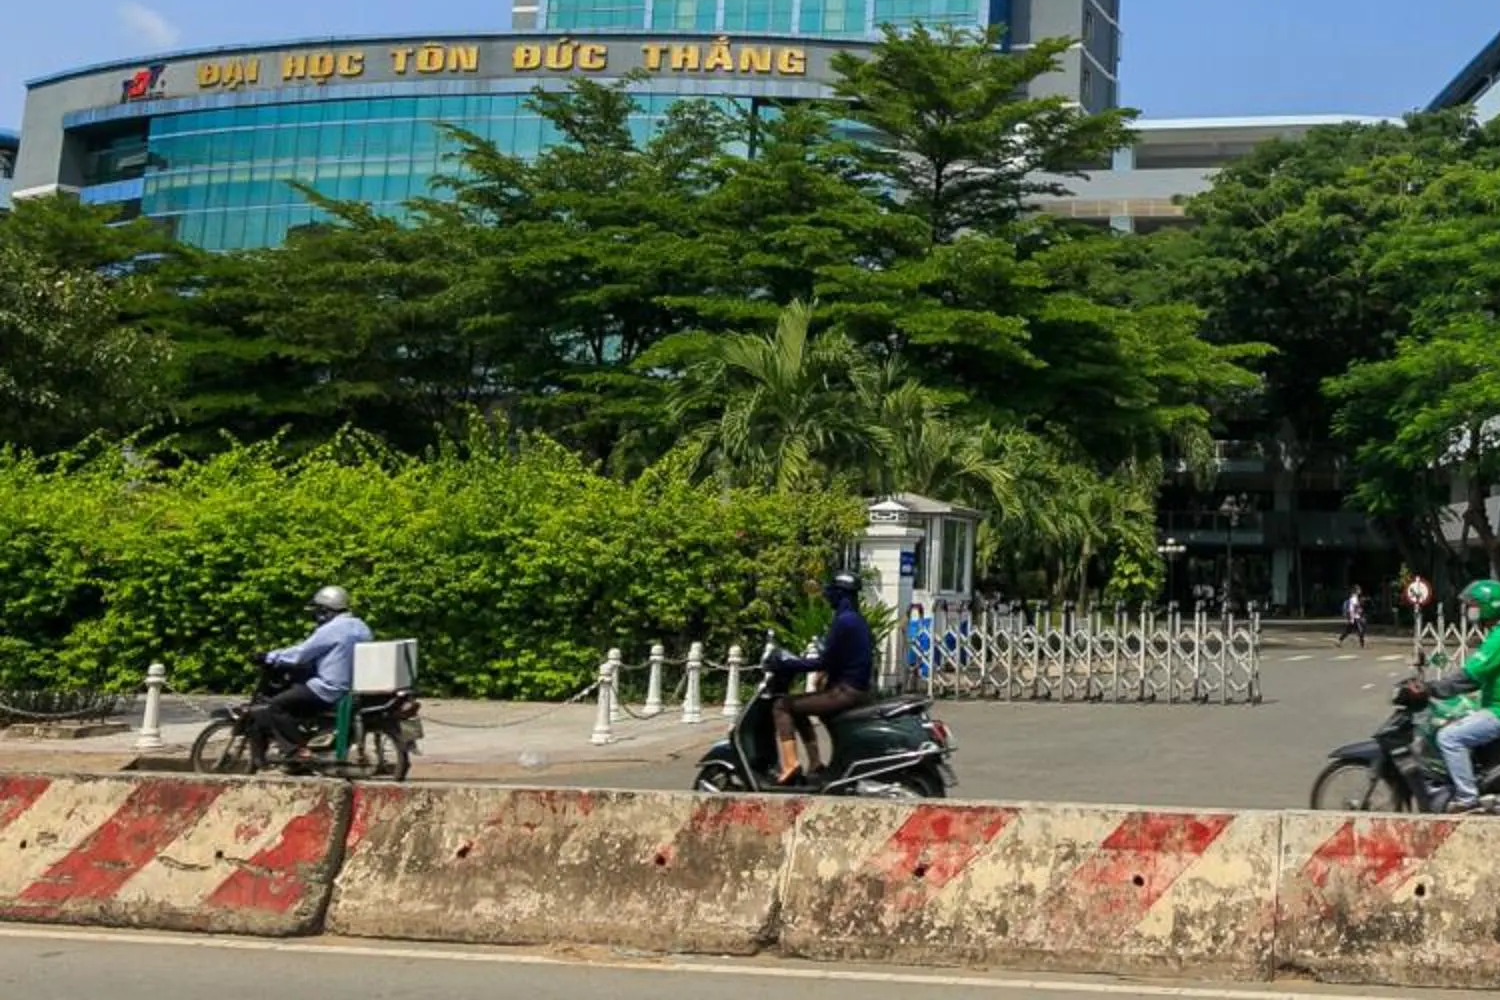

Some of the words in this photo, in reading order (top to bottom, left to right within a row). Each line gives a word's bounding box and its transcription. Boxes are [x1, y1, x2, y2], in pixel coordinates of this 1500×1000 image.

[196, 56, 260, 89] ĐẠI
[282, 51, 365, 85] HỌC
[391, 42, 481, 75] TÔN
[511, 37, 608, 71] ĐỨC
[641, 35, 807, 75] THẮNG
